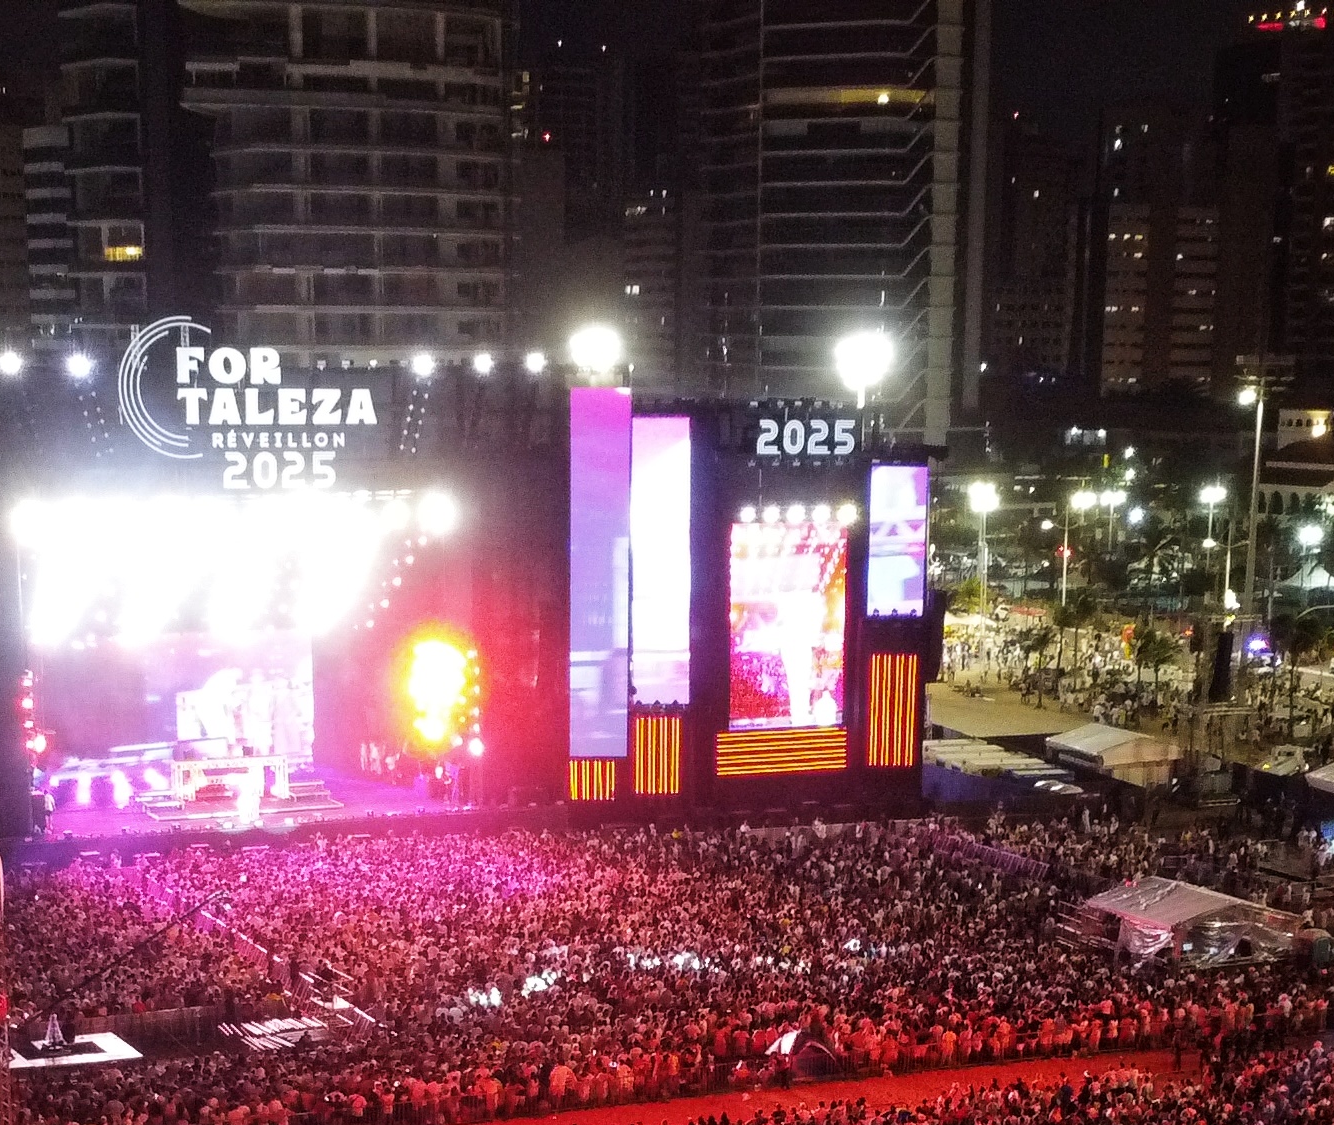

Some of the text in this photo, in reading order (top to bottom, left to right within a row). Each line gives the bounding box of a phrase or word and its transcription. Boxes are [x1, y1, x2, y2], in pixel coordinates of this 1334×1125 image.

[176, 346, 282, 385] FOR
[177, 388, 378, 425] TALEZA
[211, 429, 346, 449] RÉVEILLON
[756, 418, 856, 455] 2025
[222, 450, 337, 489] 2025
